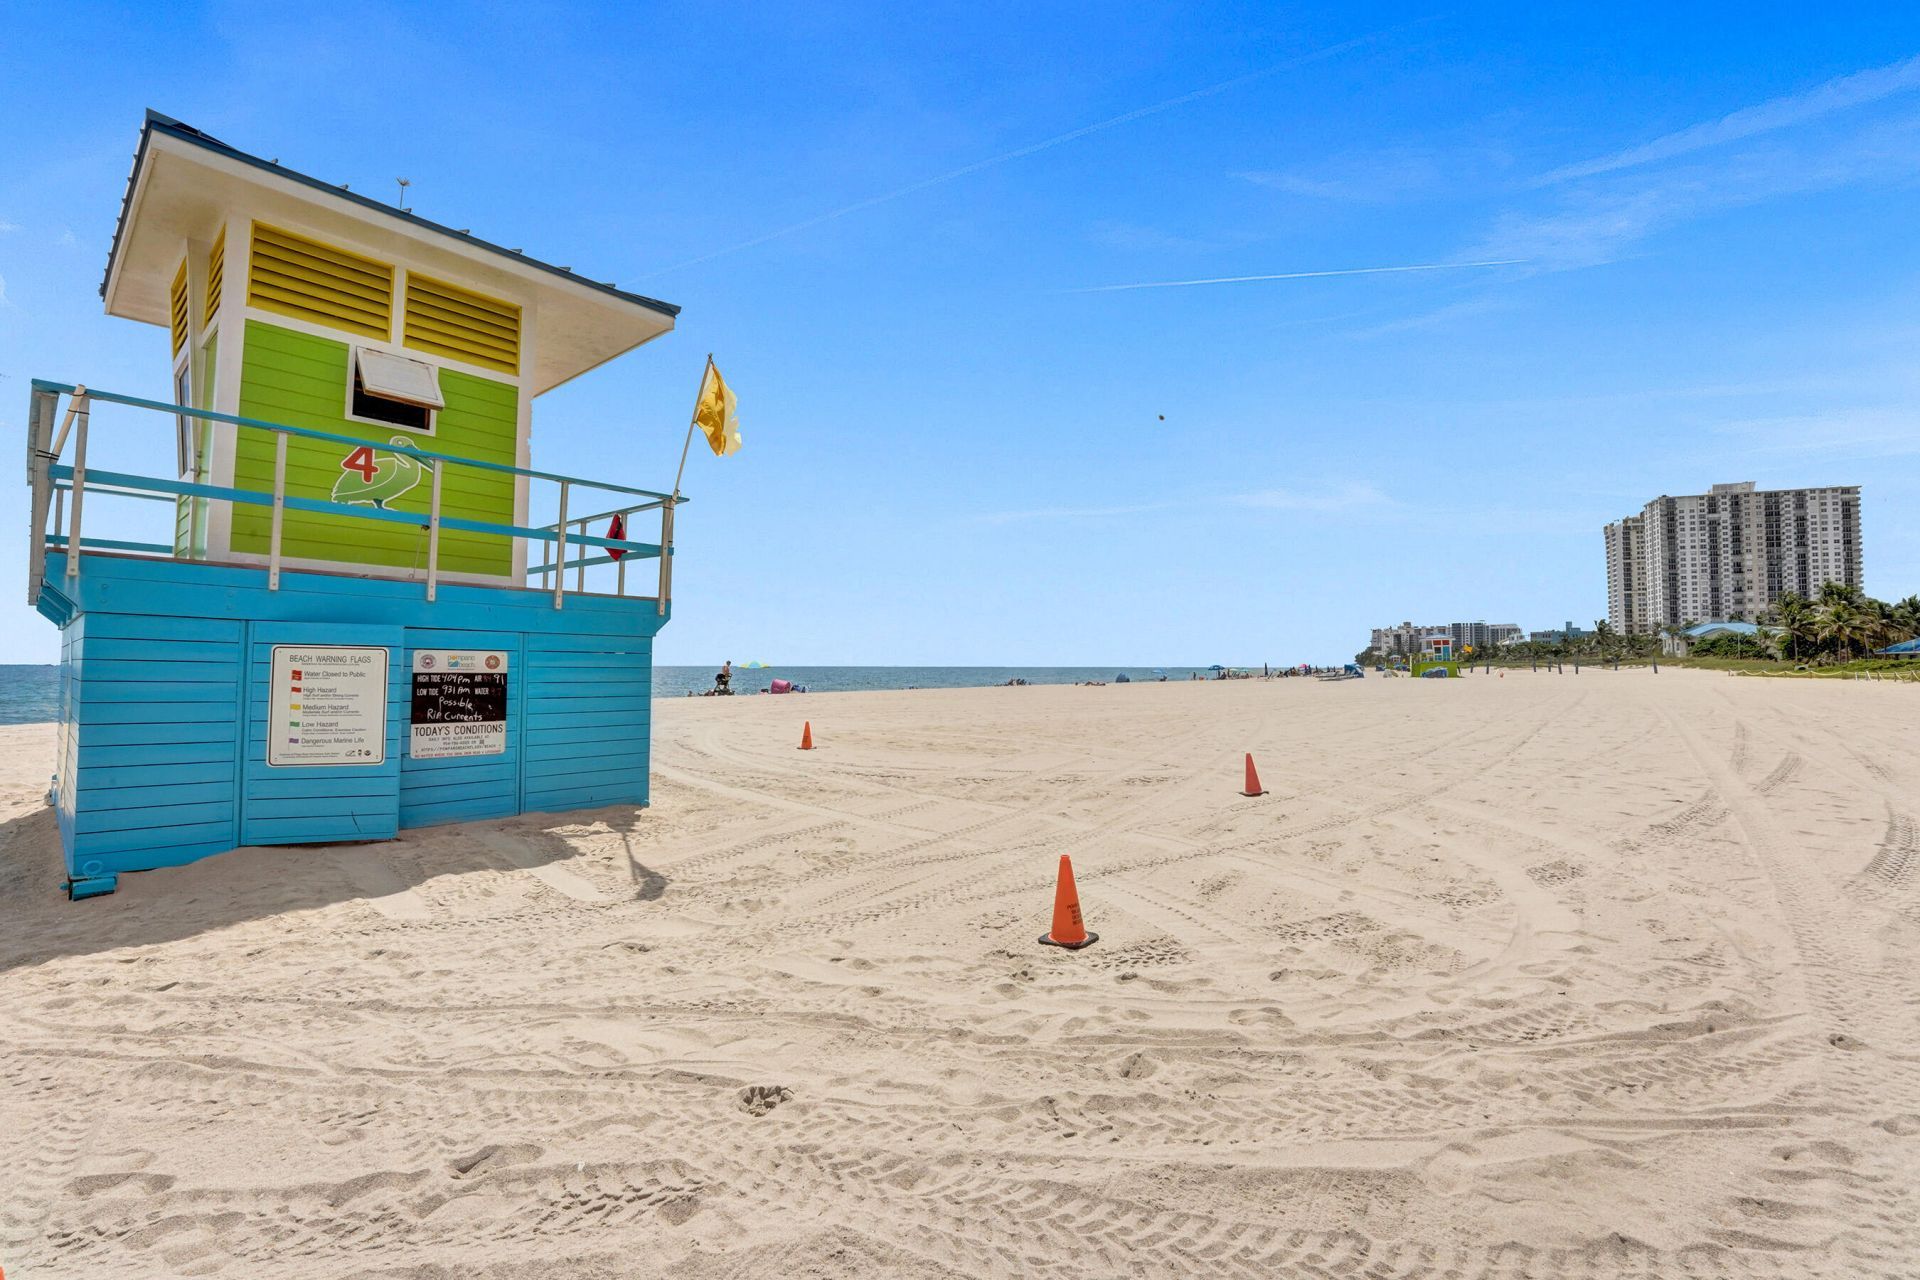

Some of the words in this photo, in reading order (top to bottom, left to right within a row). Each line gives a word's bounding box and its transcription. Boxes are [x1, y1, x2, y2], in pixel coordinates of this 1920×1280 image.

[340, 446, 380, 484] 4
[442, 685, 455, 694] 931
[438, 696, 473, 710] Possible
[445, 712, 483, 721] Currents
[415, 726, 450, 736] TODAY'S
[454, 724, 503, 735] CONDITIONS
